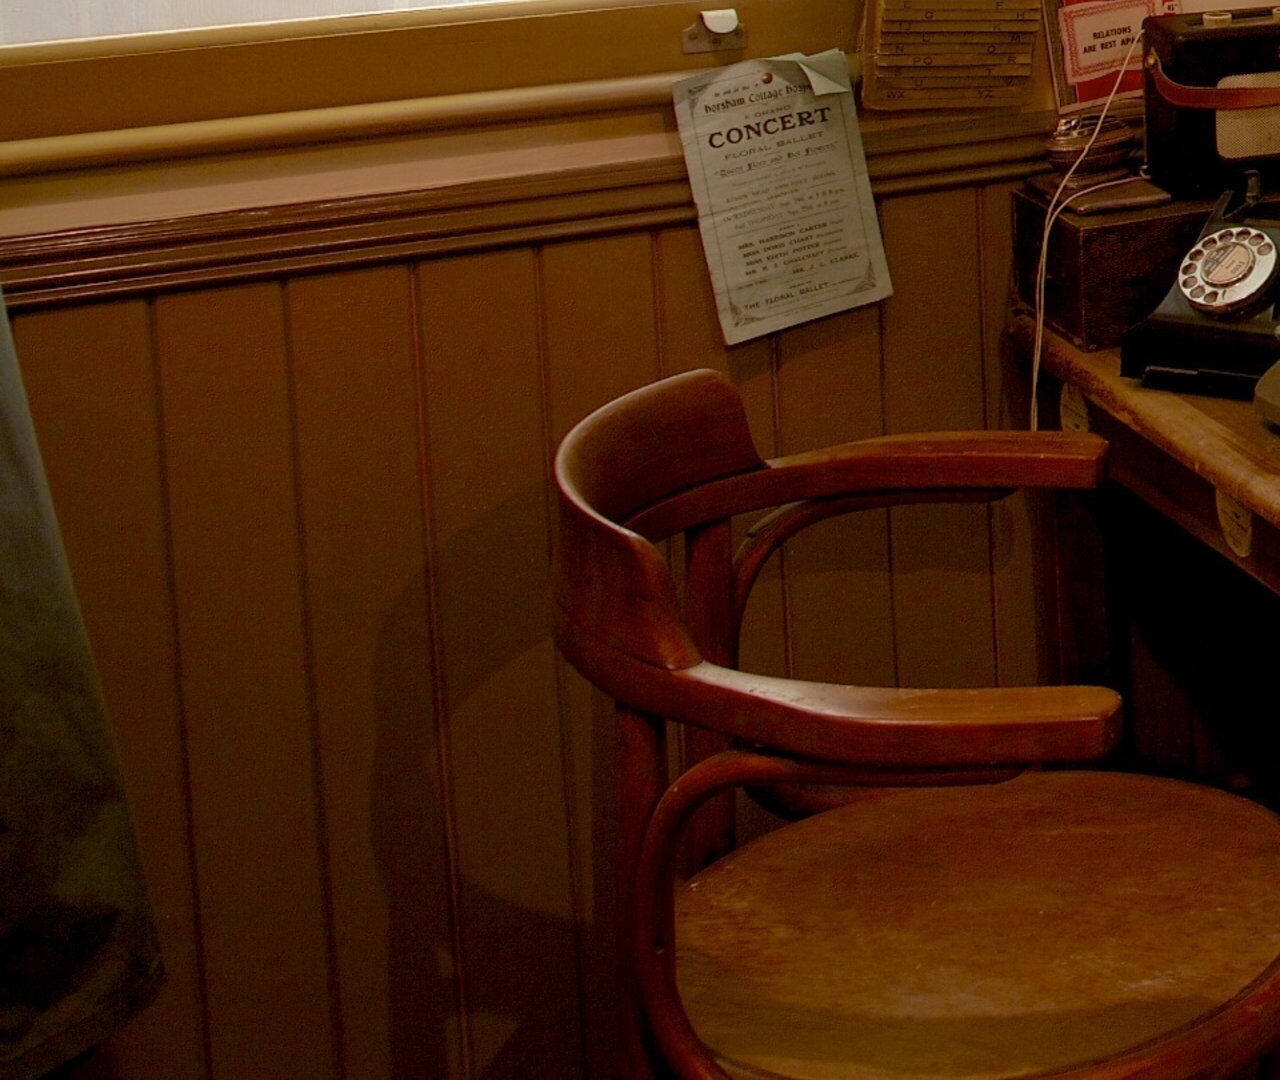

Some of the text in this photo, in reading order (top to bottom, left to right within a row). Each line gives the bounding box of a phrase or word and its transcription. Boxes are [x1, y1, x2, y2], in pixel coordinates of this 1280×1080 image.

[1093, 26, 1131, 39] RELATIONS
[1083, 40, 1116, 54] ARE BEST
[708, 107, 831, 149] CONCERT
